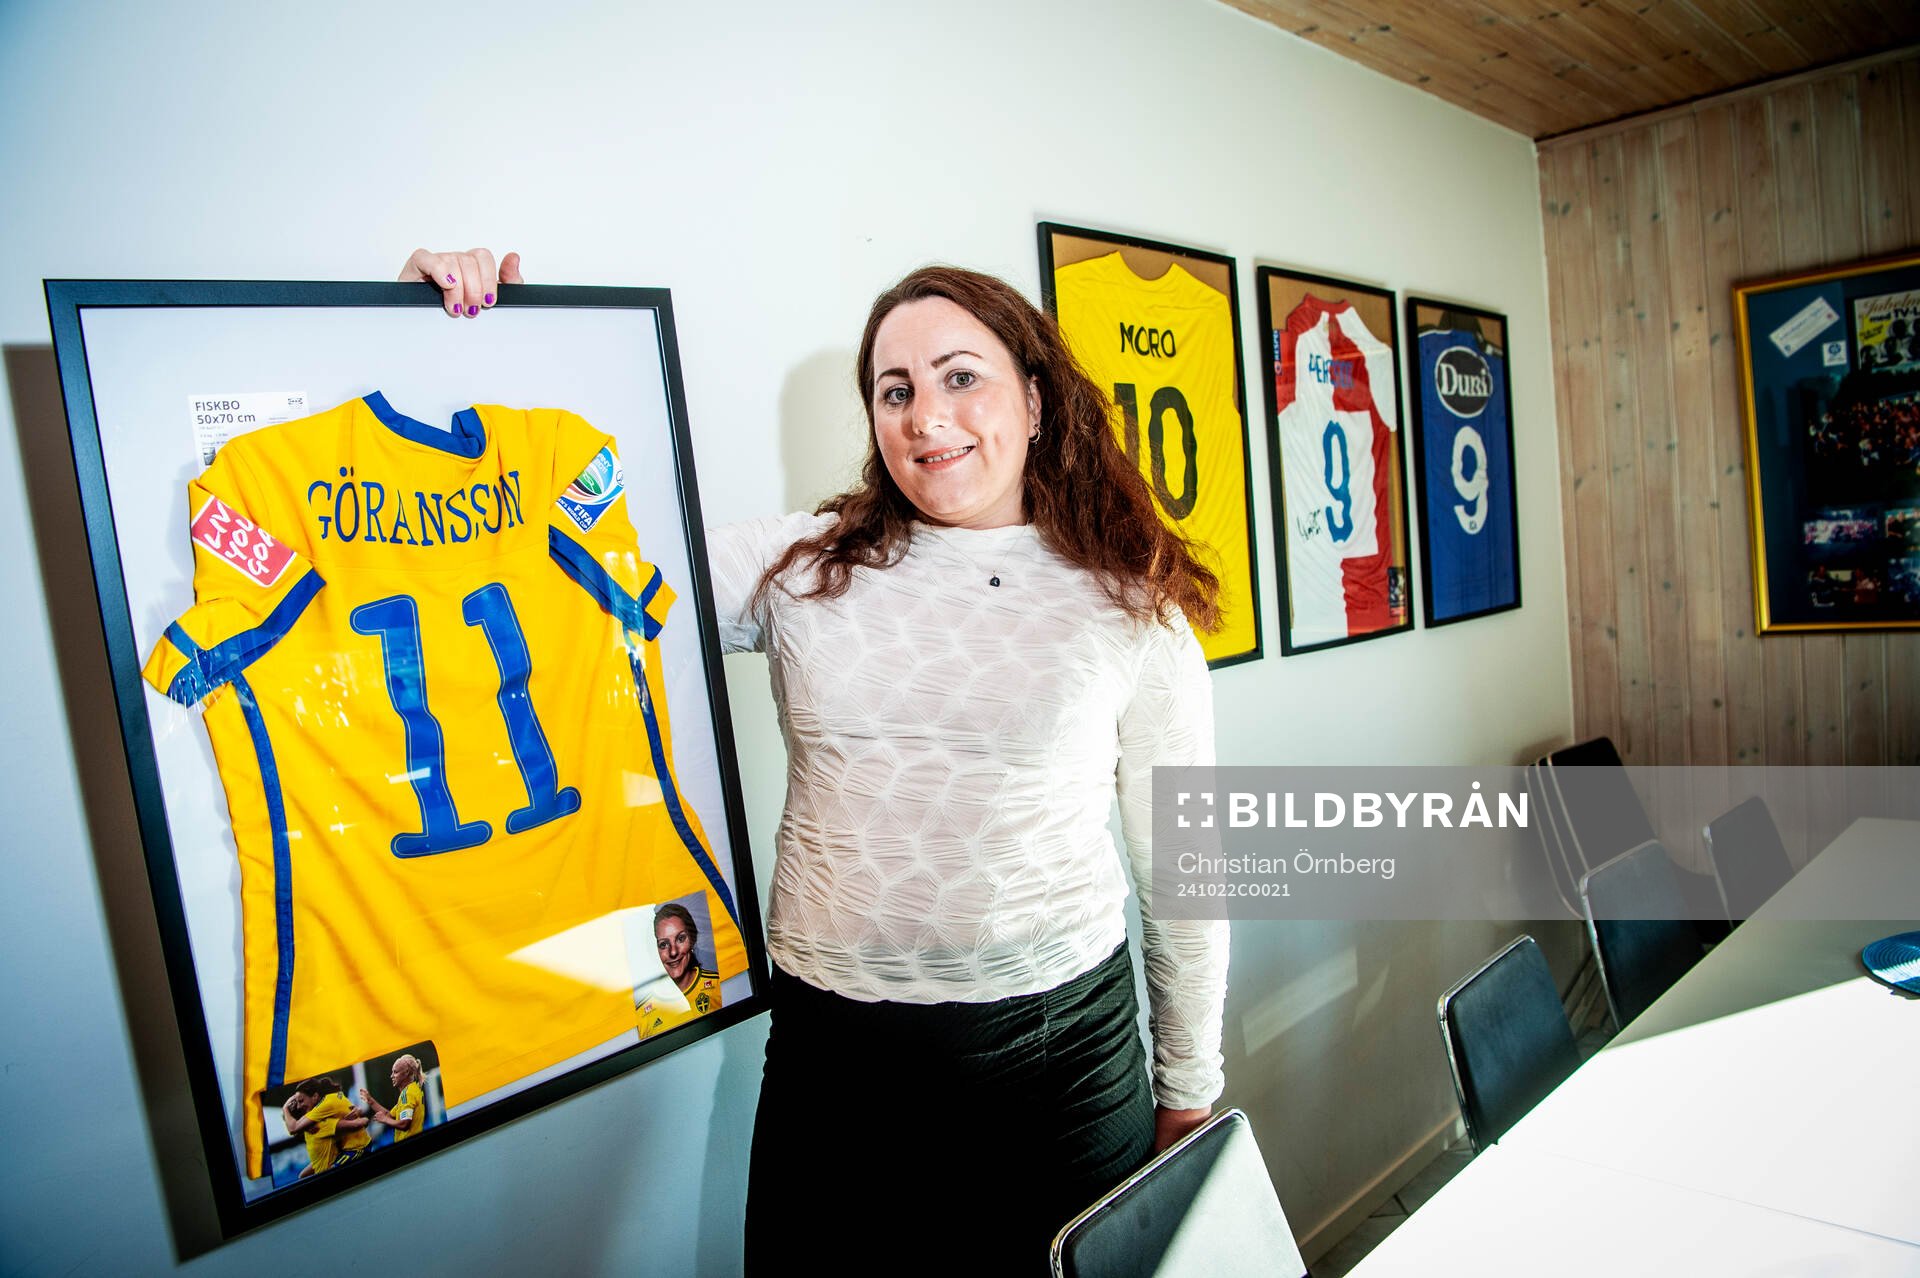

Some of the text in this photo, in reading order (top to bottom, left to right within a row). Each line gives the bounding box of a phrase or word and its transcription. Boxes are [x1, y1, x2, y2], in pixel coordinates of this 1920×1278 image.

[1119, 321, 1177, 359] MORO
[195, 400, 240, 412] FISKBO
[1440, 363, 1489, 397] Duni
[197, 413, 234, 425] 50x70
[237, 414, 256, 424] cm
[1113, 382, 1199, 521] 10
[1451, 425, 1489, 535] 9
[307, 466, 525, 547] GÖRANSSON
[1322, 420, 1354, 543] 9
[573, 504, 593, 526] FIFA
[349, 581, 583, 860] 11
